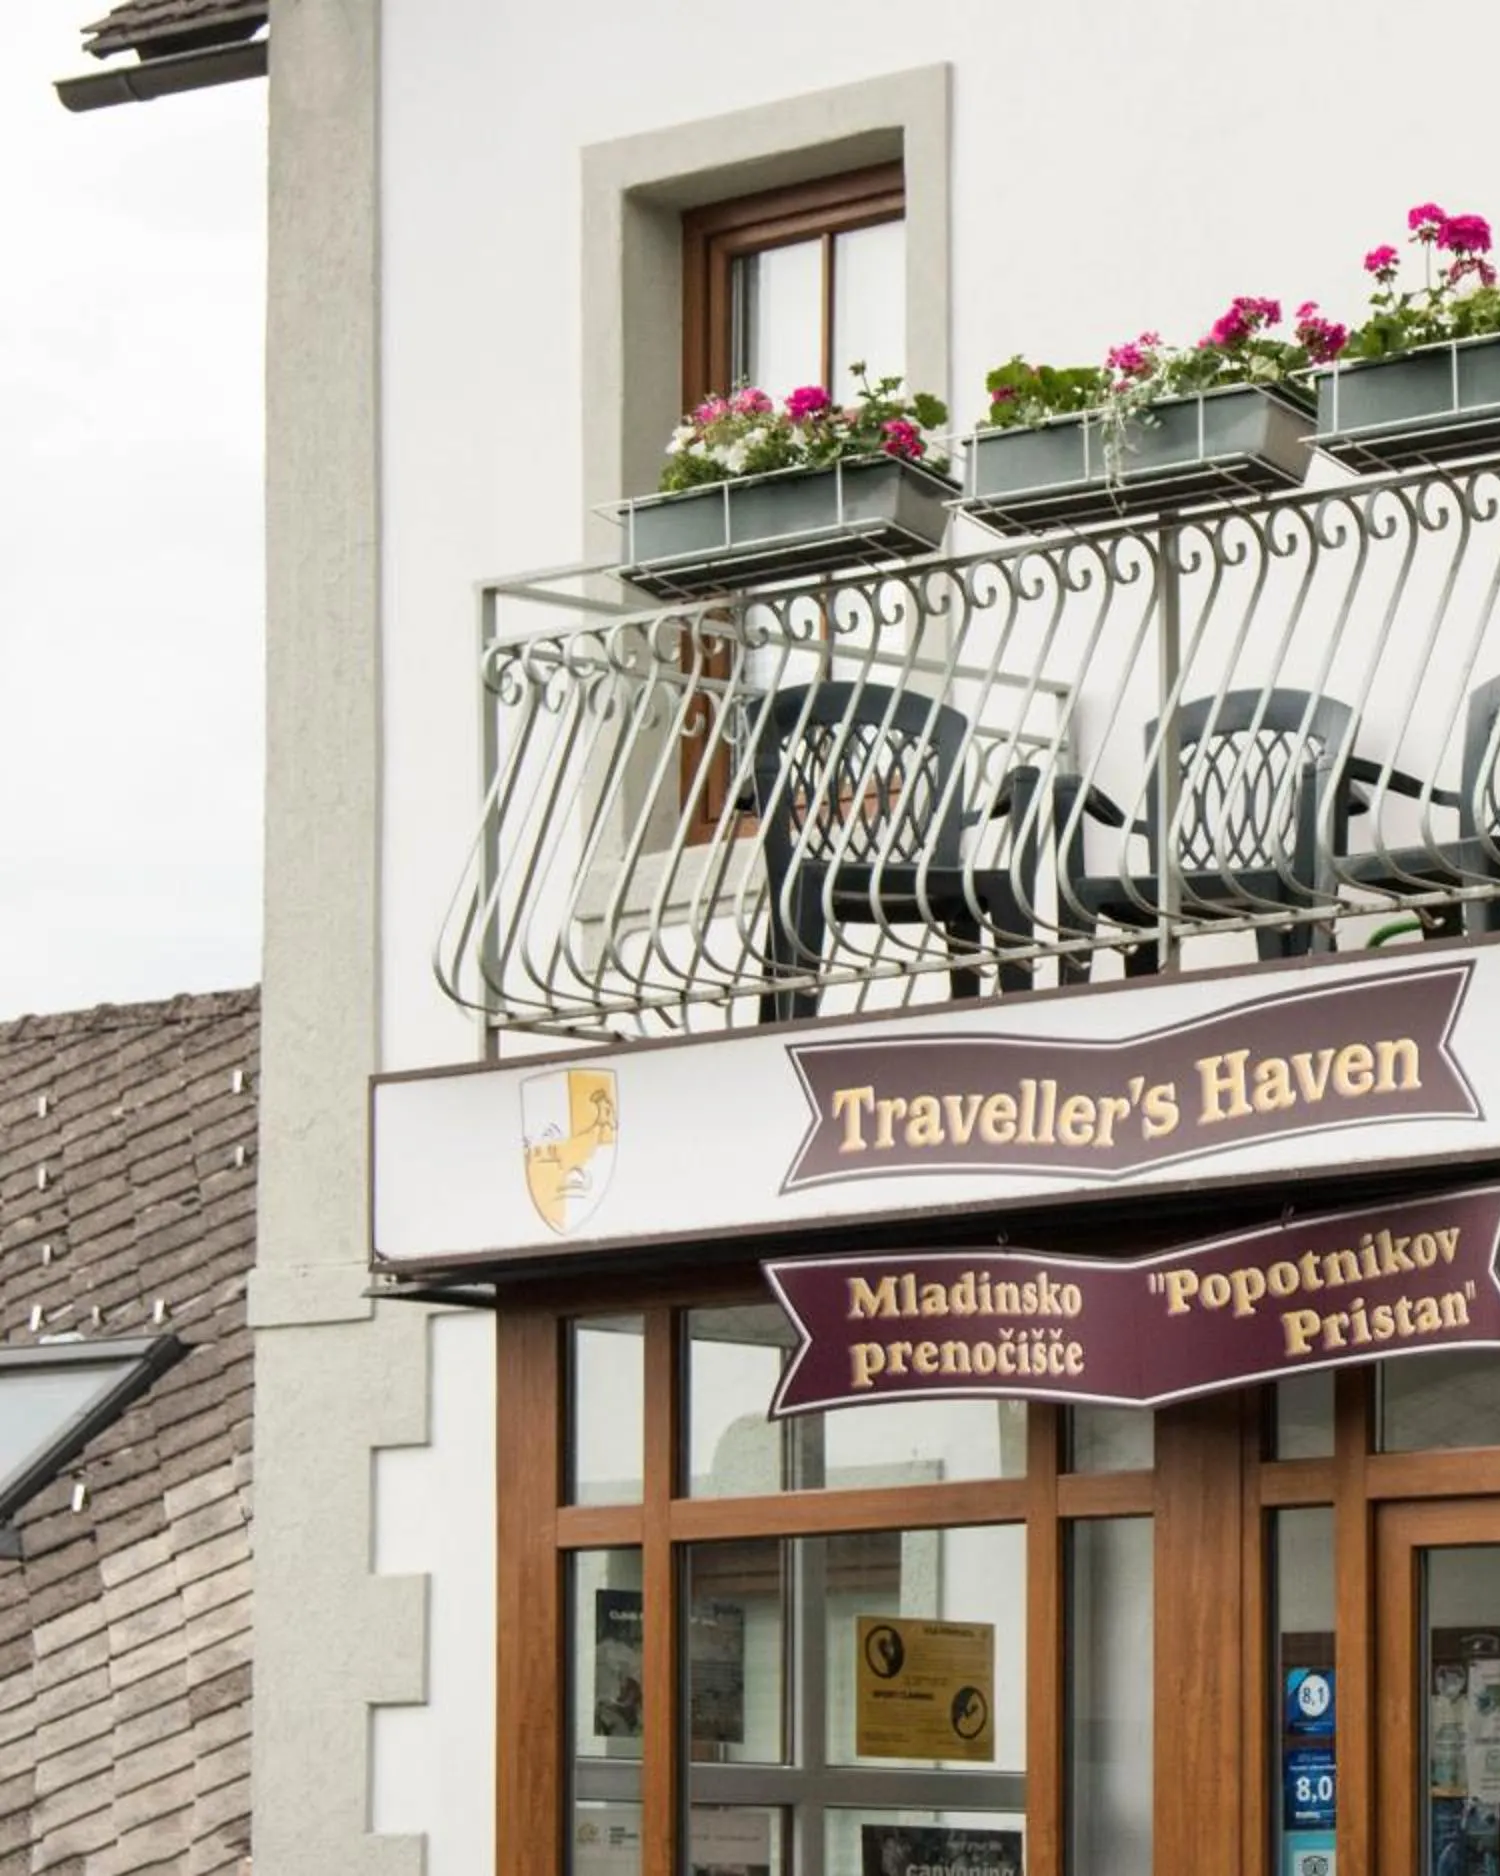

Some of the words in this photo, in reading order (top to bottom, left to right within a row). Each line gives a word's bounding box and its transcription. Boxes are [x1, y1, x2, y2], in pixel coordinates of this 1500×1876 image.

[832, 1076, 1179, 1153] Traveller's
[1195, 1036, 1421, 1124] Haven
[847, 1271, 1082, 1320] Mladinsko
[1148, 1224, 1461, 1317] "Popotnikov
[1280, 1280, 1477, 1358] Pristan"
[850, 1329, 1085, 1389] prenočišče
[1302, 1686, 1325, 1706] 8,1
[1295, 1775, 1334, 1803] 8,0
